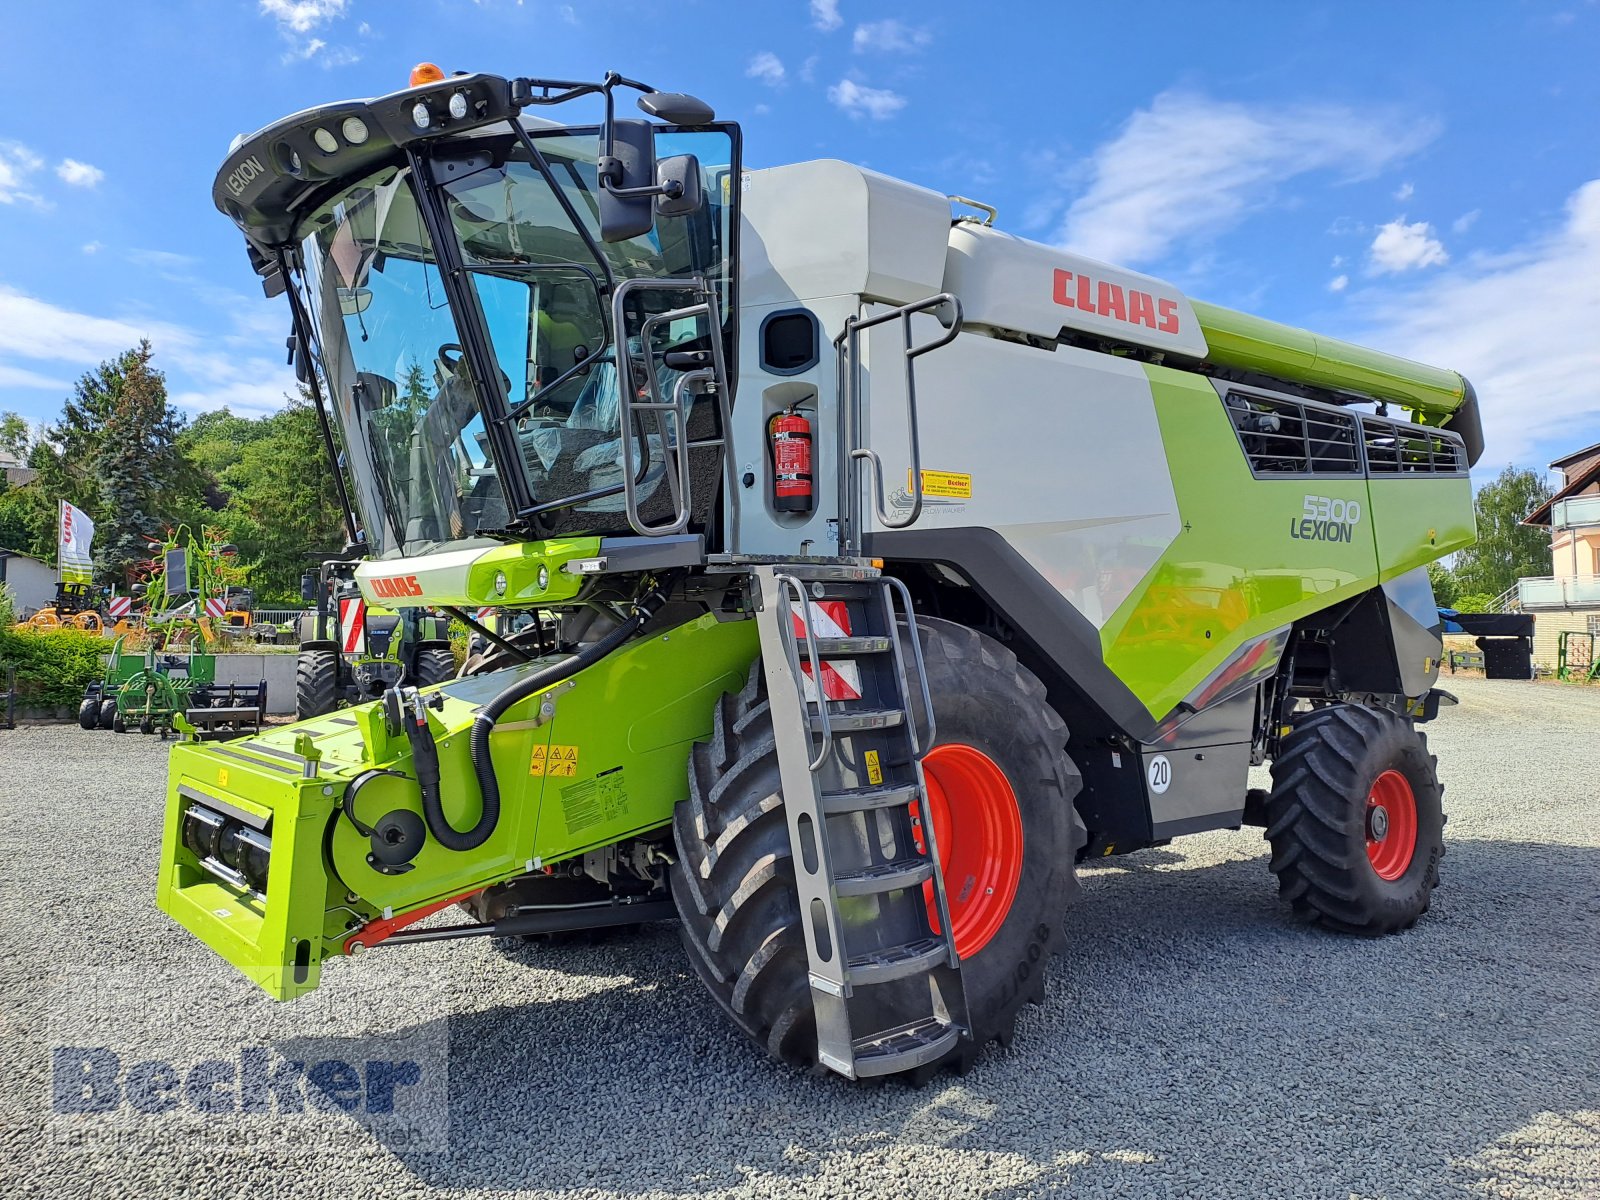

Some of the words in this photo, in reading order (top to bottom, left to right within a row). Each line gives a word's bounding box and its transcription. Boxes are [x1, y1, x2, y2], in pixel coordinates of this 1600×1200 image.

[225, 155, 265, 196] LEXION
[1053, 268, 1179, 334] CLAAS
[64, 504, 73, 543] CLAAS
[1303, 494, 1361, 524] 5300
[1290, 517, 1352, 543] LEXION
[370, 575, 424, 598] CLAAS
[1152, 761, 1168, 786] 20
